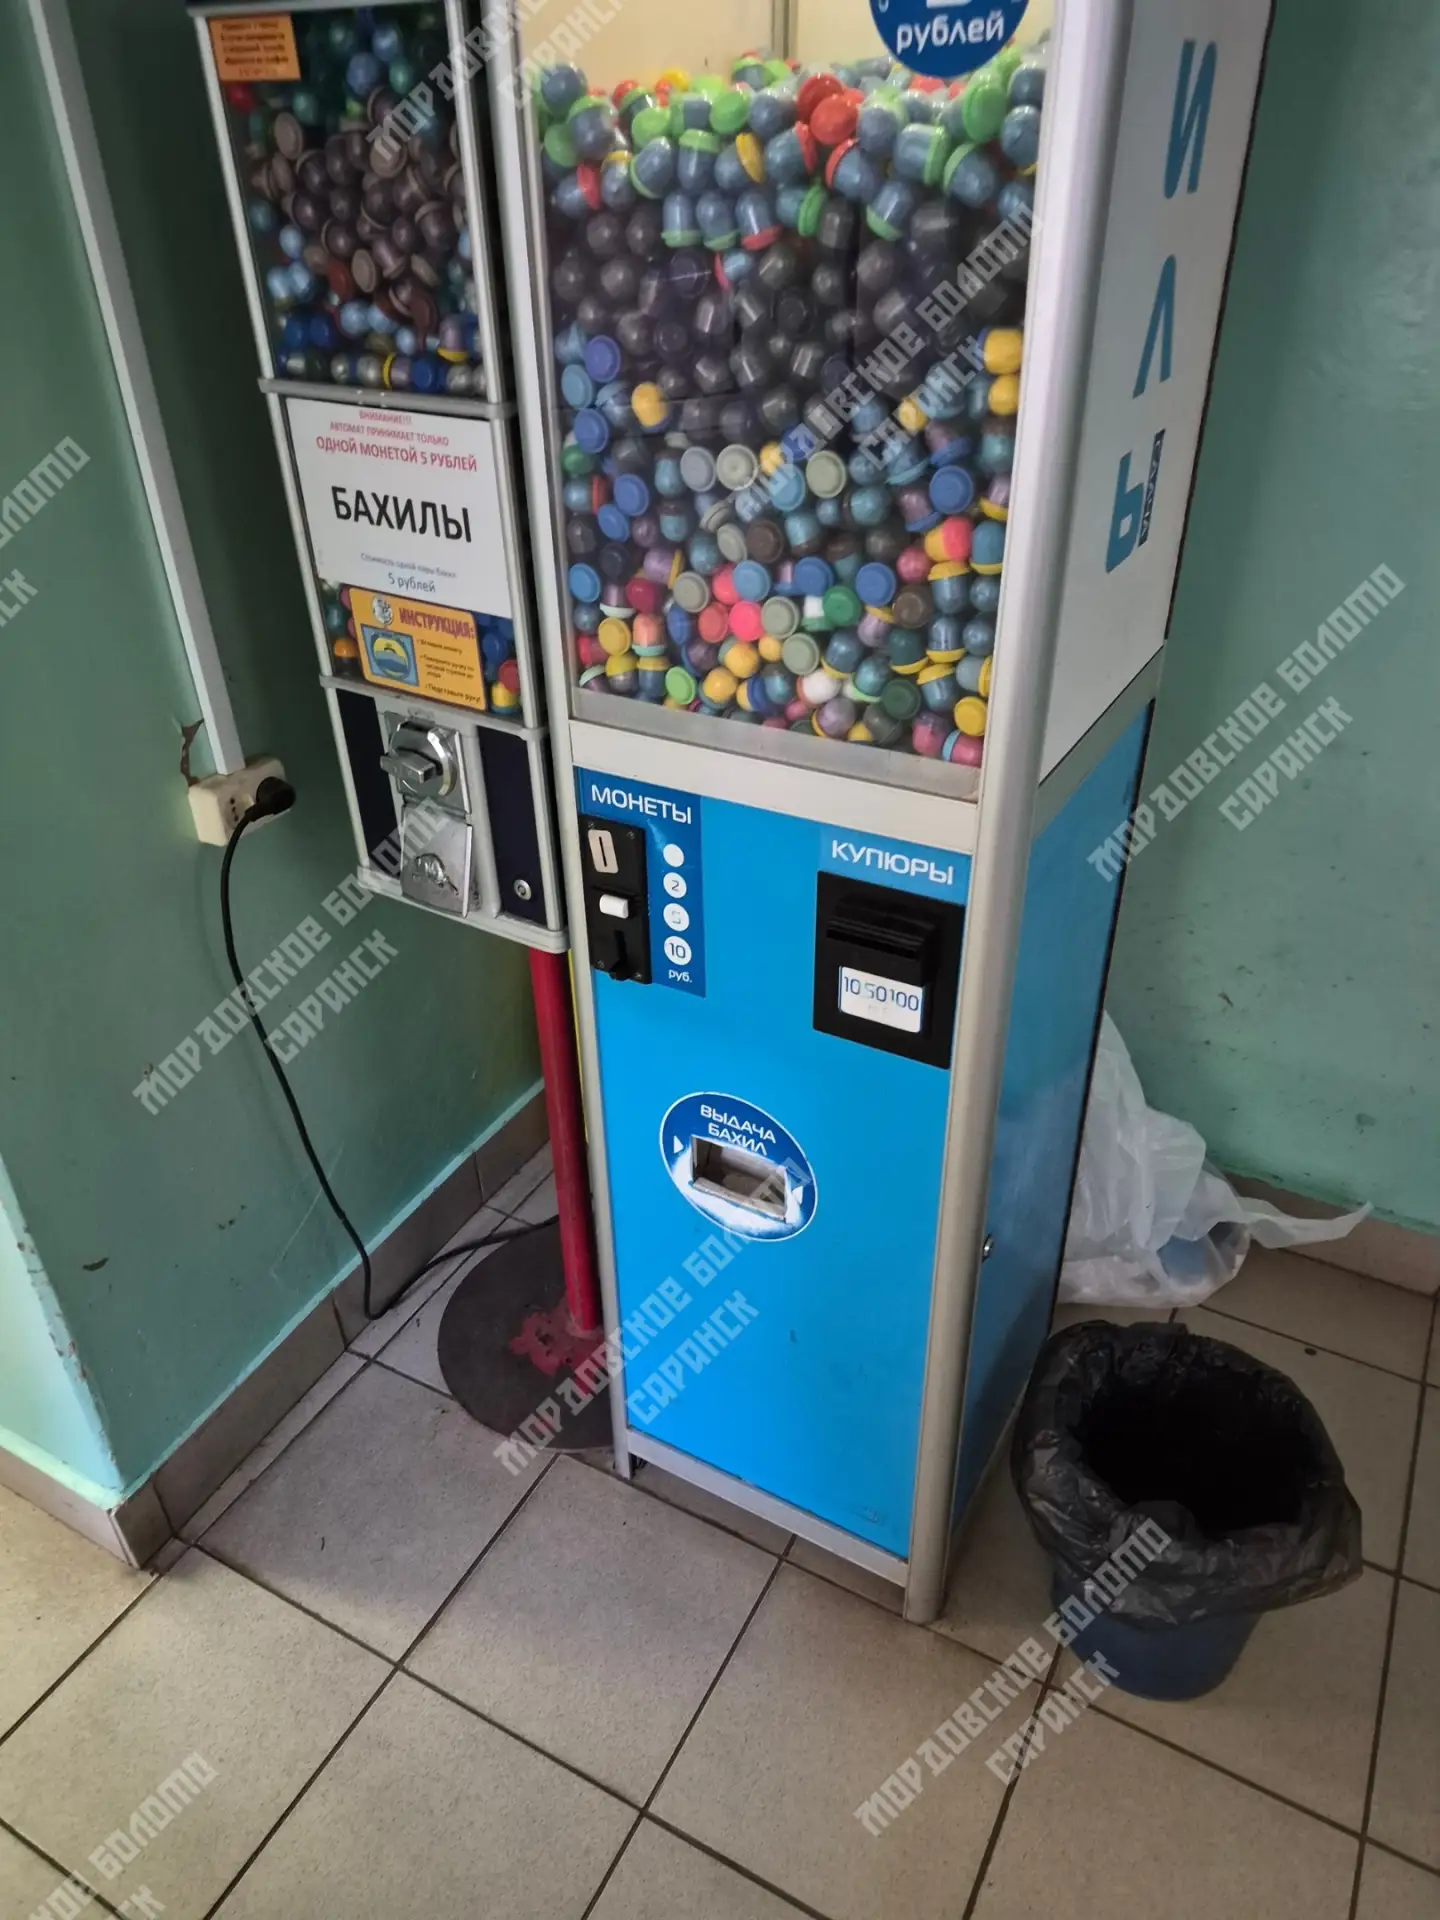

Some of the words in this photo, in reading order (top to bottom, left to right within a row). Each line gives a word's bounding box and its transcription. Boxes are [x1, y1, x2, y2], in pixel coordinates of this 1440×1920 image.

[896, 10, 1005, 55] рублей
[330, 421, 365, 434] АВТОМАТ
[416, 432, 450, 446] ТОЛЬКО
[316, 435, 358, 454] ОДНОЙ
[359, 441, 418, 463] МОНЕТОЙ
[420, 451, 429, 464] 5
[430, 452, 478, 472] РУБЛЕЙ
[331, 485, 472, 543] БАХИЛЫ
[388, 571, 395, 585] 5
[397, 576, 436, 592] рублей
[591, 784, 692, 825] МОНЕТЫ
[831, 839, 953, 885] КУПЮРЫ
[671, 879, 680, 892] 2
[669, 942, 687, 959] 10
[668, 969, 693, 983] руб.
[844, 975, 861, 995] 10
[890, 988, 920, 1011] 100
[700, 1104, 777, 1144] ВЫДАЧА
[708, 1122, 767, 1156] БАХИЛ
